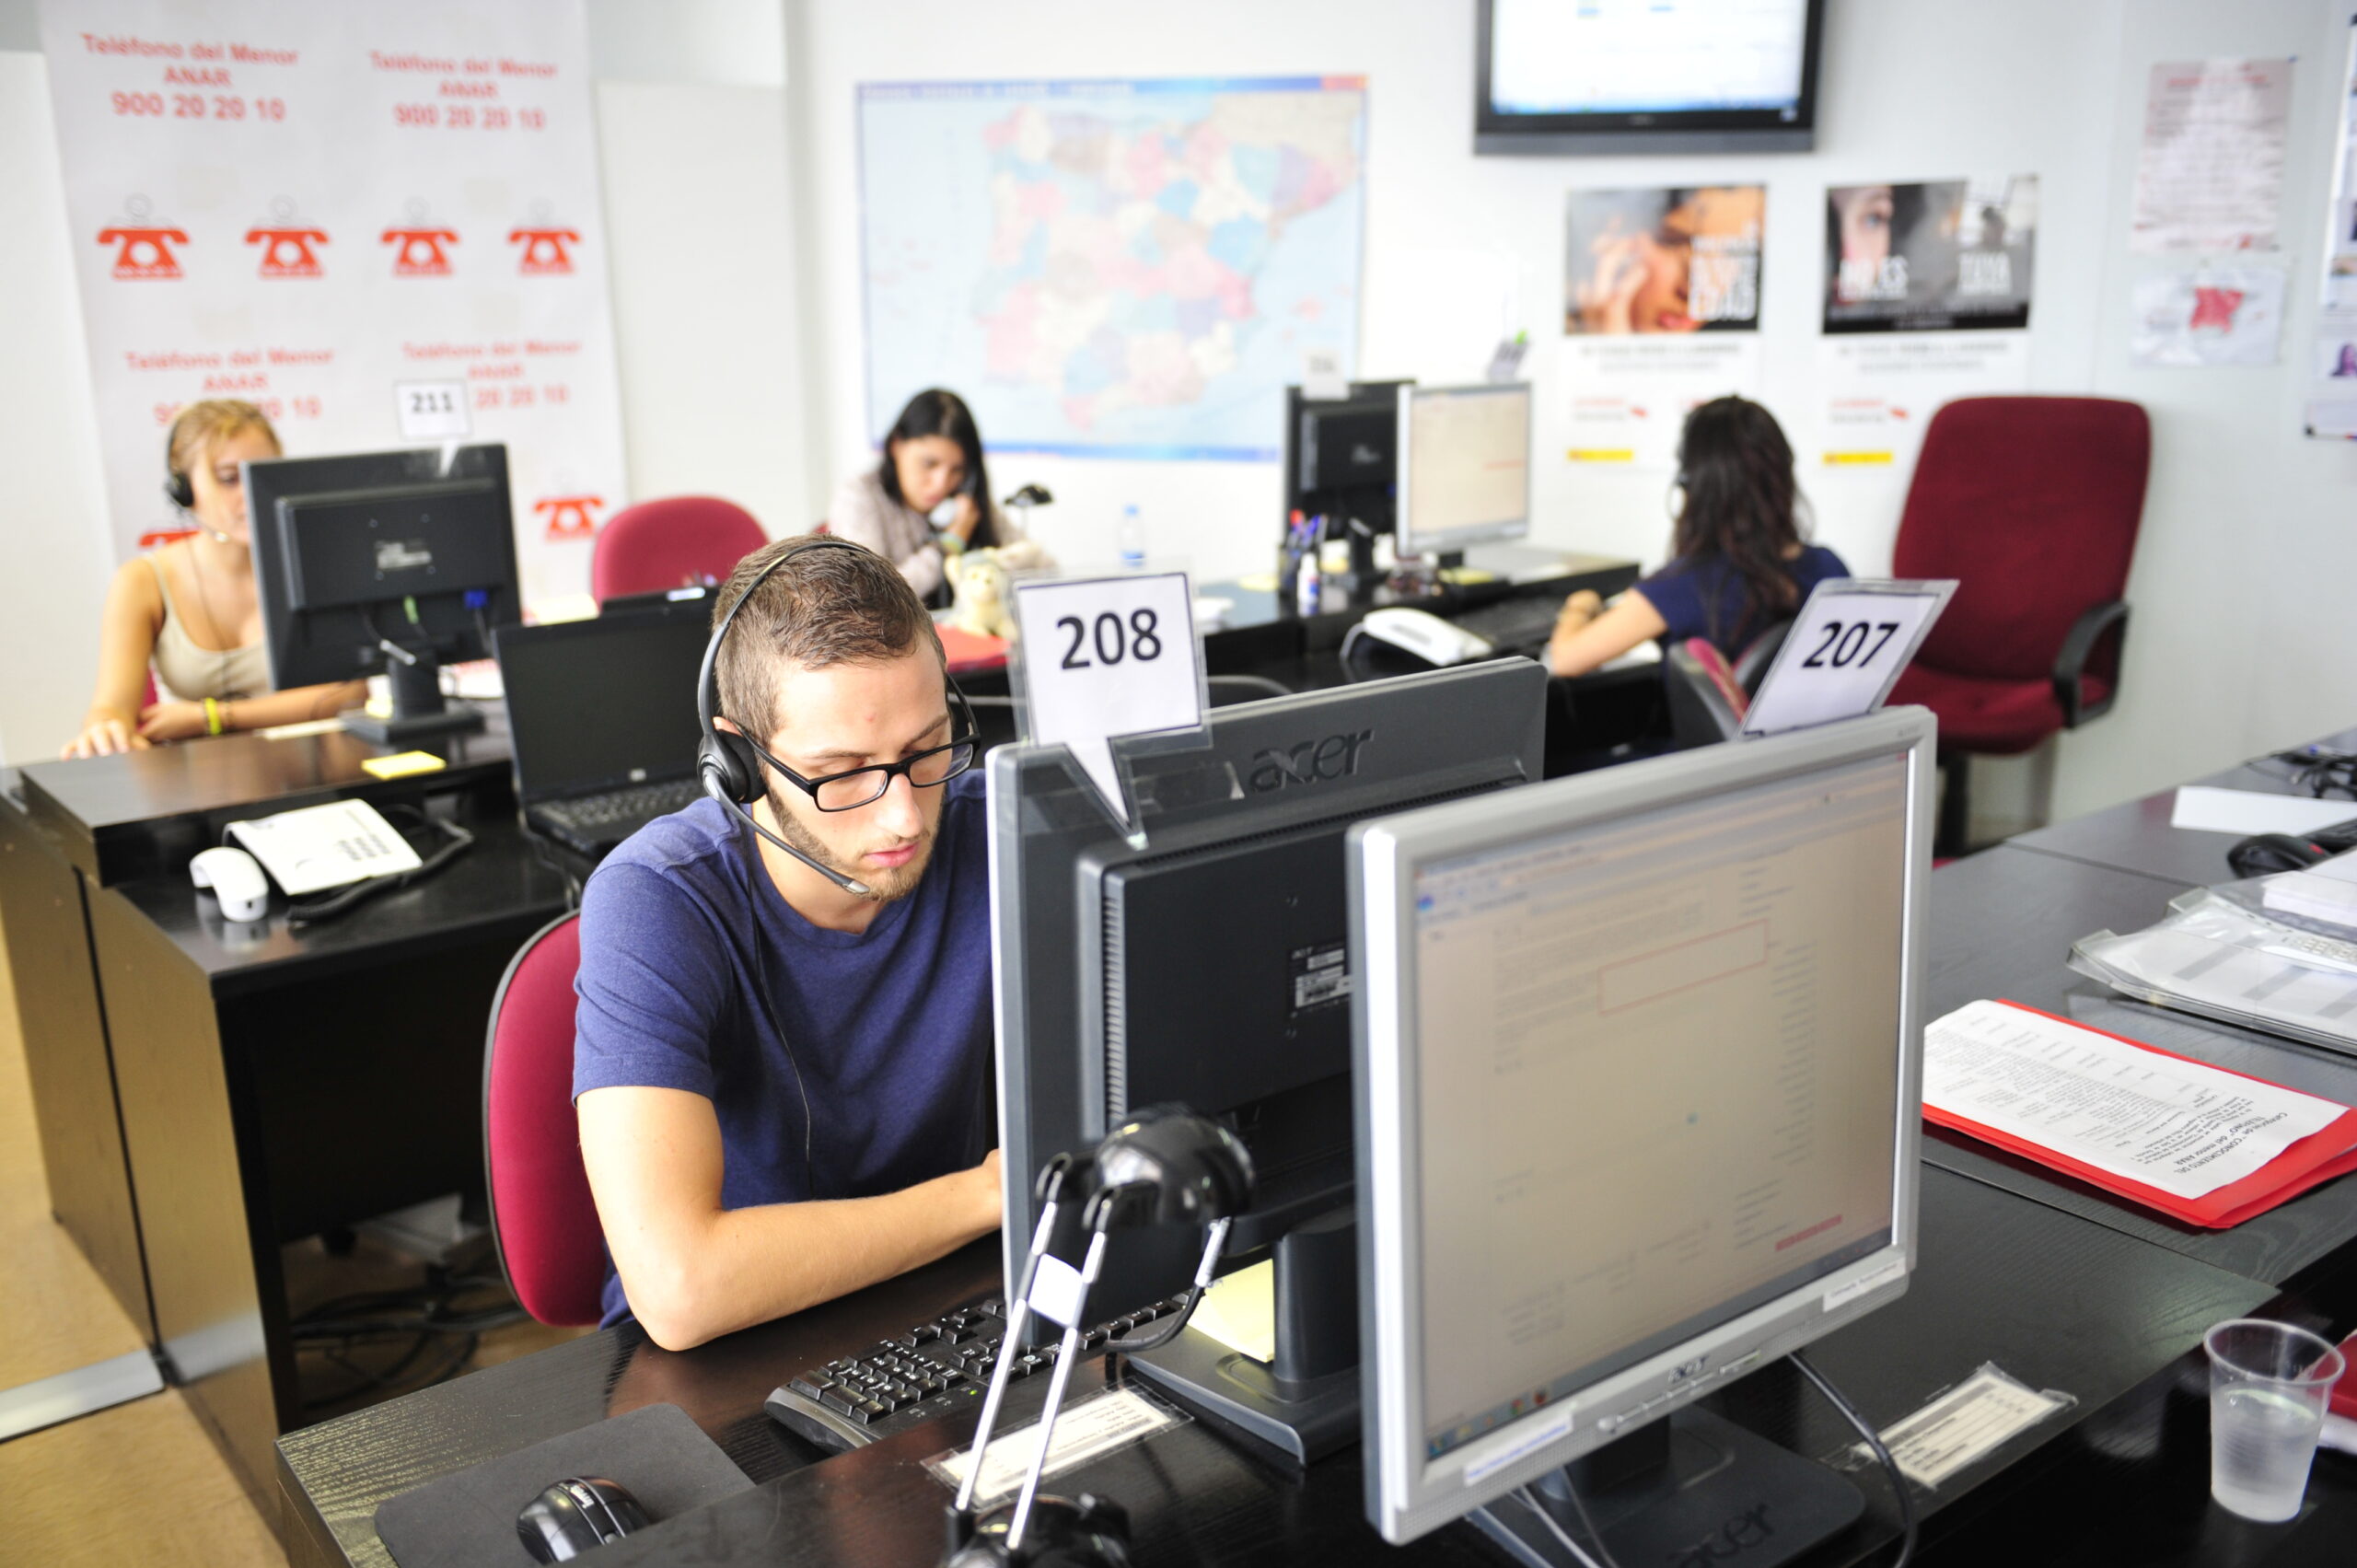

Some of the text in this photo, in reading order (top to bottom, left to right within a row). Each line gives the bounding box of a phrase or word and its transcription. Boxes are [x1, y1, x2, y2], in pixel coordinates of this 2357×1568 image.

[80, 32, 299, 65] Teléfono del Menor
[164, 64, 233, 87] ANAR
[370, 51, 458, 75] Teléfono
[495, 58, 557, 78] Menor
[438, 80, 498, 99] ANAR
[110, 90, 286, 122] 900 20 20 10
[393, 102, 545, 131] 900 20 20 10
[124, 349, 223, 370] Teléfono
[266, 345, 335, 366] Menor
[202, 370, 270, 393] ANAR
[290, 394, 323, 421] 10
[411, 391, 454, 413] 211
[1056, 609, 1162, 670] 208
[1801, 621, 1900, 668] 207
[1249, 728, 1374, 792] acer
